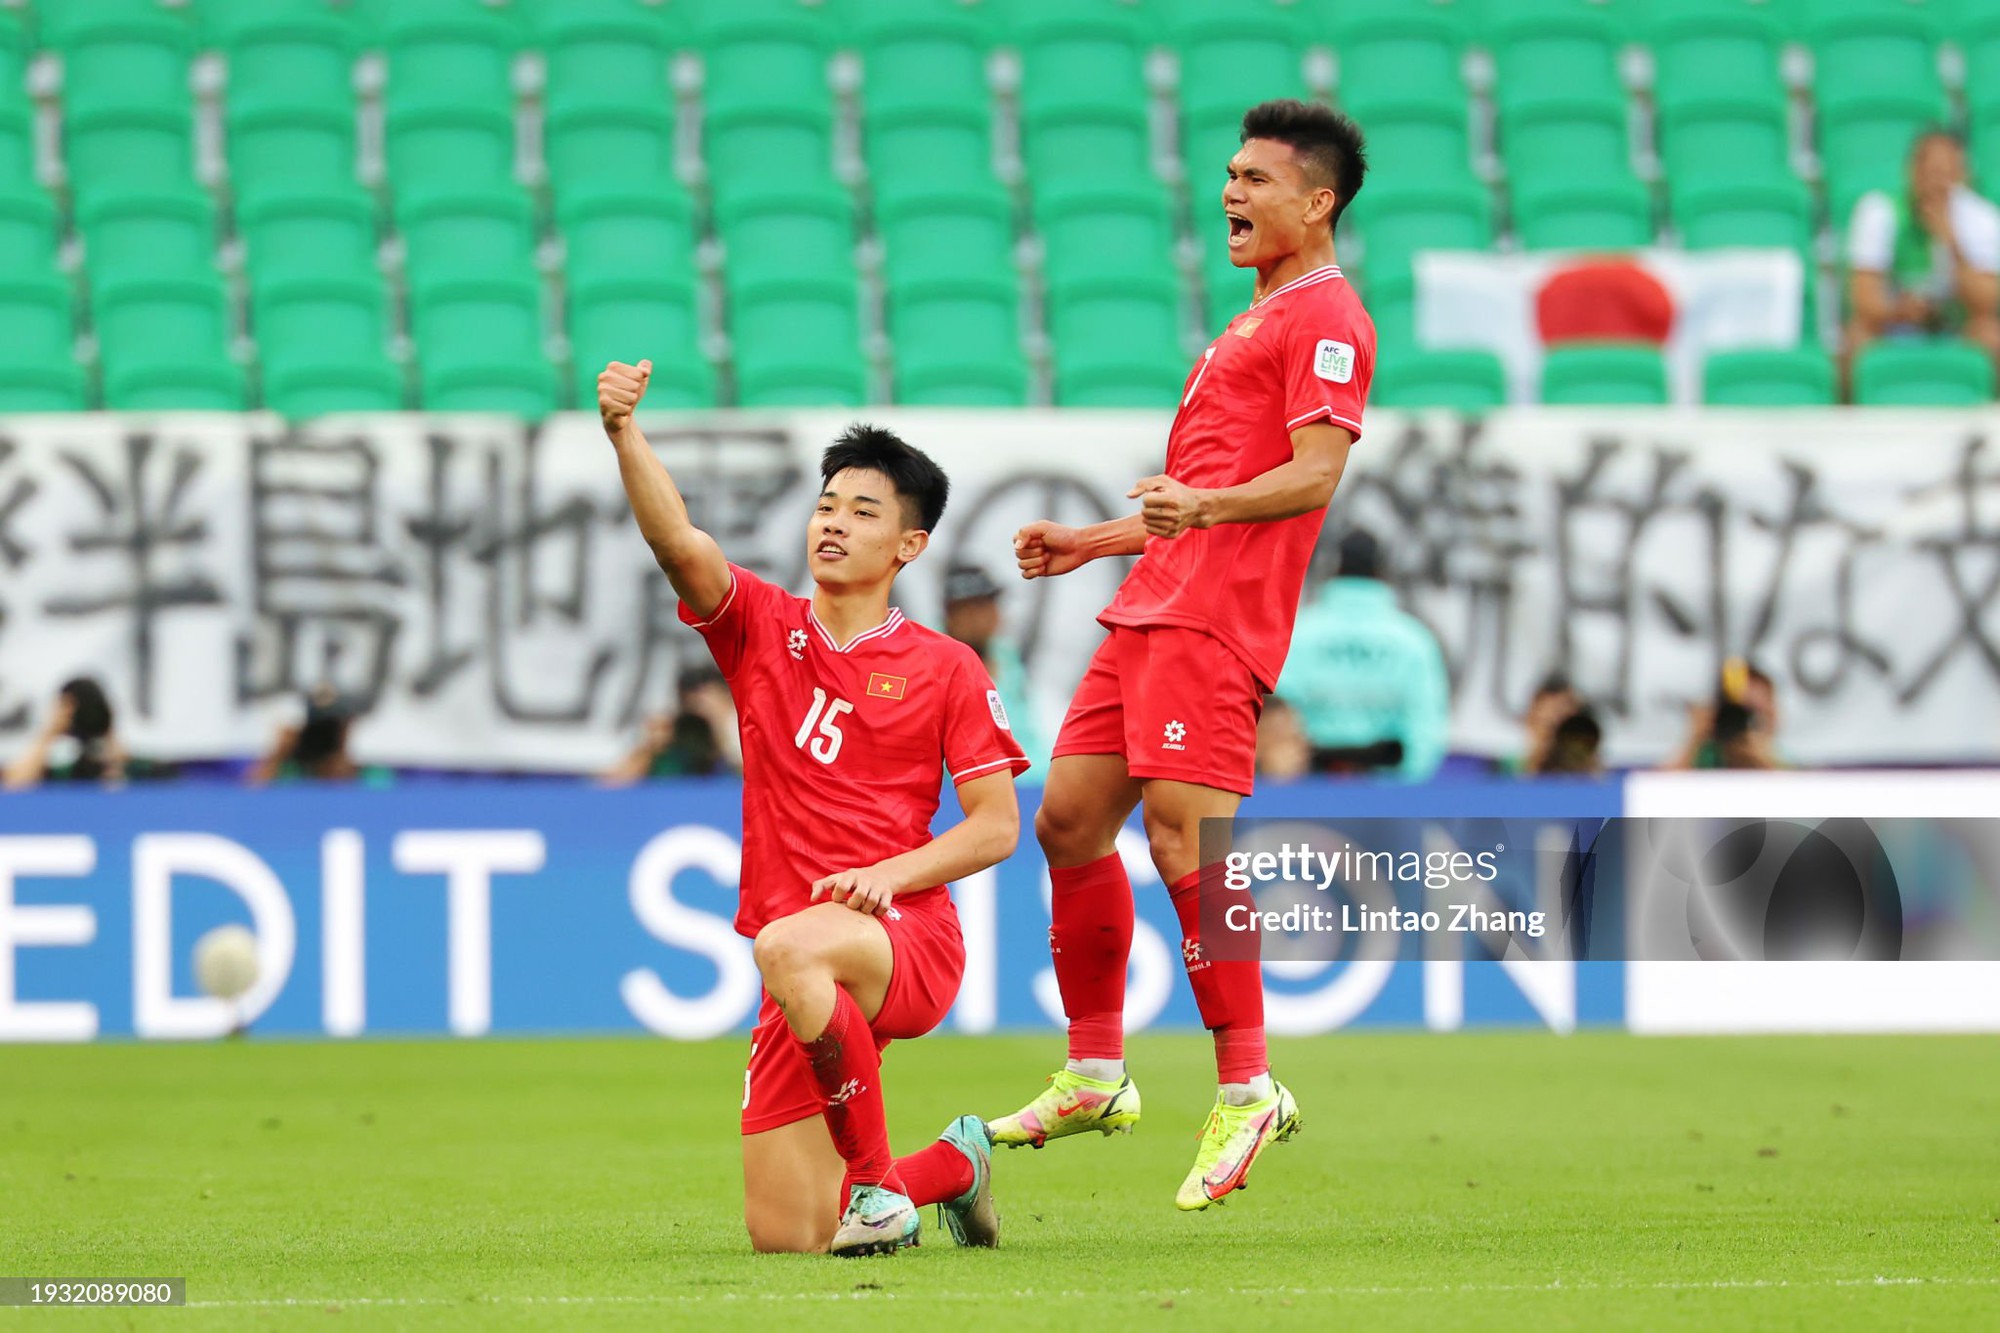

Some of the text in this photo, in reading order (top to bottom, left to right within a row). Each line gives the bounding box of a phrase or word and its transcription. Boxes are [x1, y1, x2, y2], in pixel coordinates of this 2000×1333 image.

[1321, 352, 1348, 367] LIVE
[1324, 346, 1340, 354] AFC
[794, 686, 854, 765] 15
[0, 822, 1578, 1041] EDIT SISON
